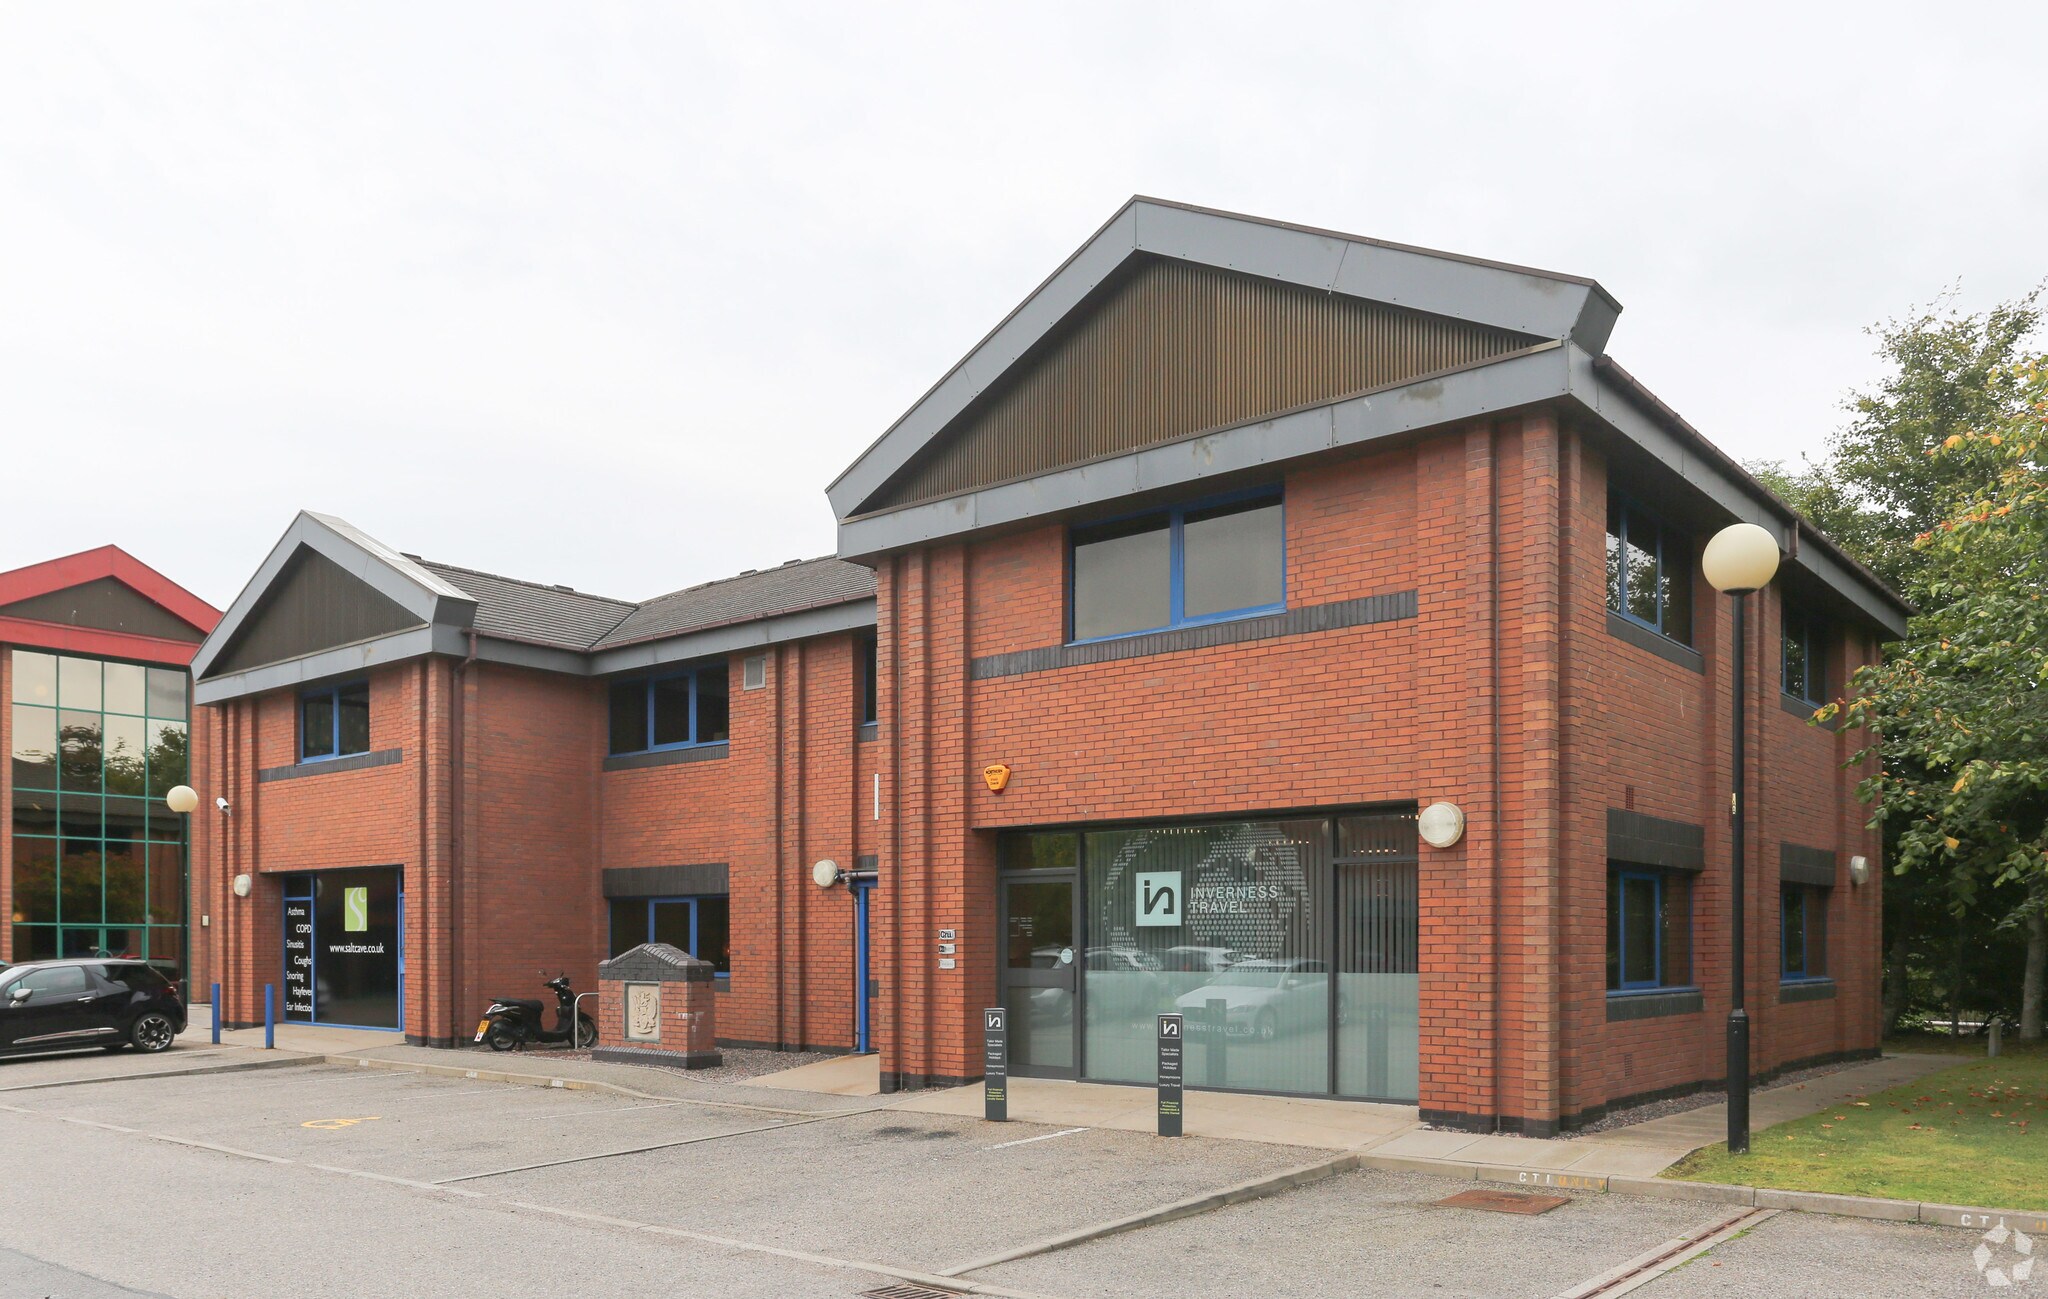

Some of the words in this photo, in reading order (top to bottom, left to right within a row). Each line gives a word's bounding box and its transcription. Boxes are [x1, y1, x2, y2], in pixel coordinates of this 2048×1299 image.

[1190, 886, 1278, 899] INVERNESS
[287, 907, 305, 916] Asthma
[1190, 901, 1248, 914] TRAVEL
[296, 924, 312, 933] COPD
[286, 940, 304, 948] Sinusitis
[329, 942, 384, 954] www.saltcave.co.uk
[294, 956, 312, 968] Coughs
[286, 971, 304, 982] Snoring
